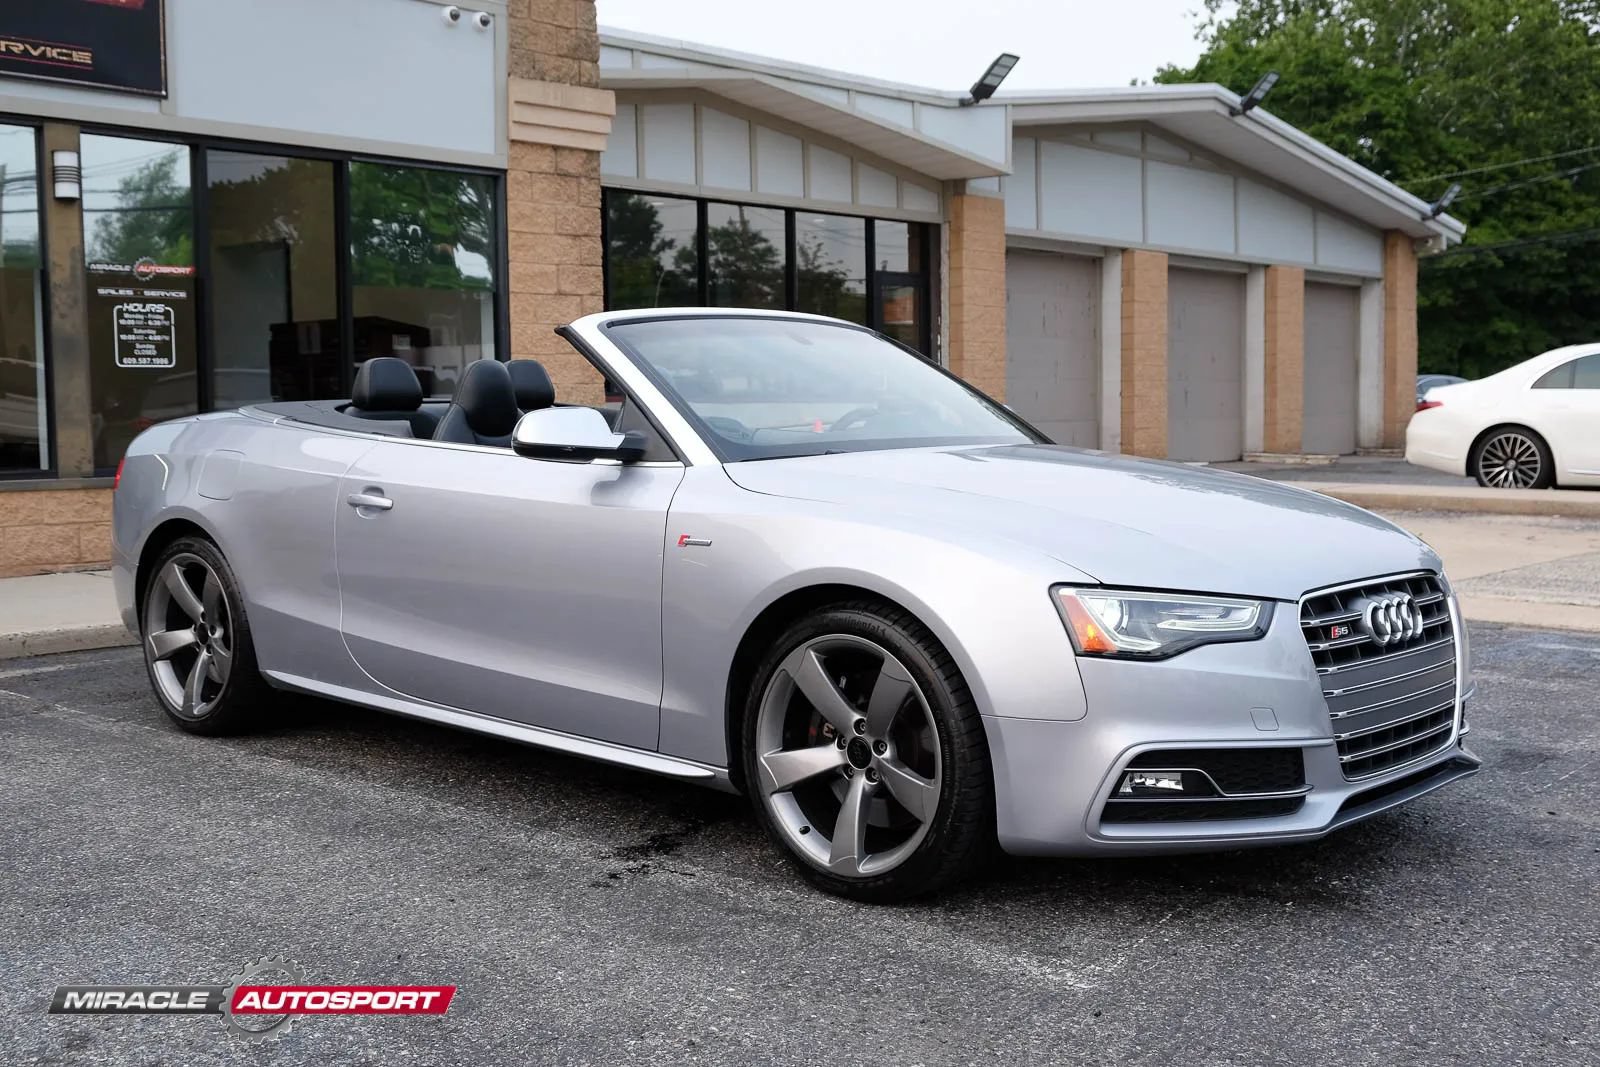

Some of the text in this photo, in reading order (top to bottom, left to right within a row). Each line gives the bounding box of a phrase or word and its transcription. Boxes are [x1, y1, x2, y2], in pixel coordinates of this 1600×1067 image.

[90, 263, 191, 274] MIRACLE AUTOSPORT
[123, 302, 165, 313] HOURS
